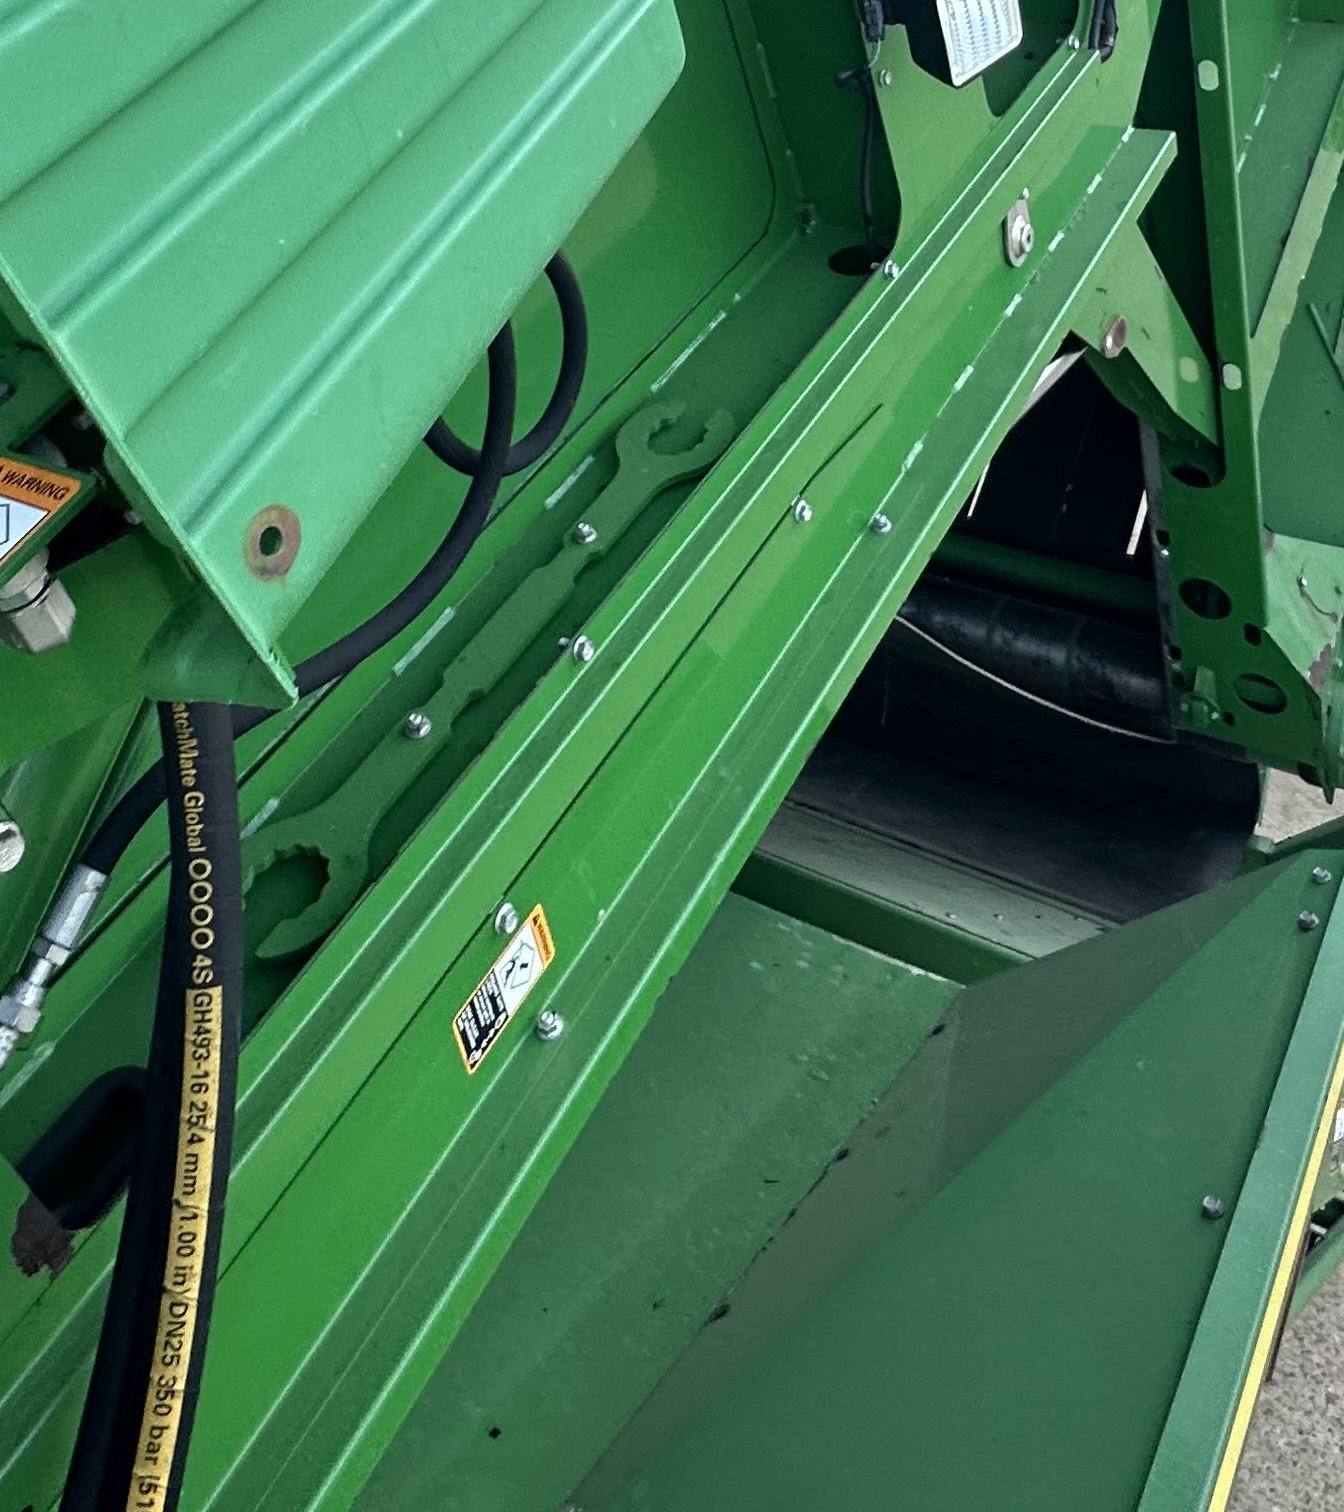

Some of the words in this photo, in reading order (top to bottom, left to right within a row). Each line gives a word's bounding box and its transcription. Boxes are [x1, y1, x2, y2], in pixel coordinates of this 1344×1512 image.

[1, 469, 70, 501] WARNING
[183, 790, 207, 853] Global
[192, 954, 214, 984] 4S
[189, 990, 213, 1095] GH493-16
[182, 1152, 200, 1197] mm
[161, 1301, 190, 1367] DN25
[153, 1374, 178, 1417] 350
[144, 1425, 170, 1466] bar
